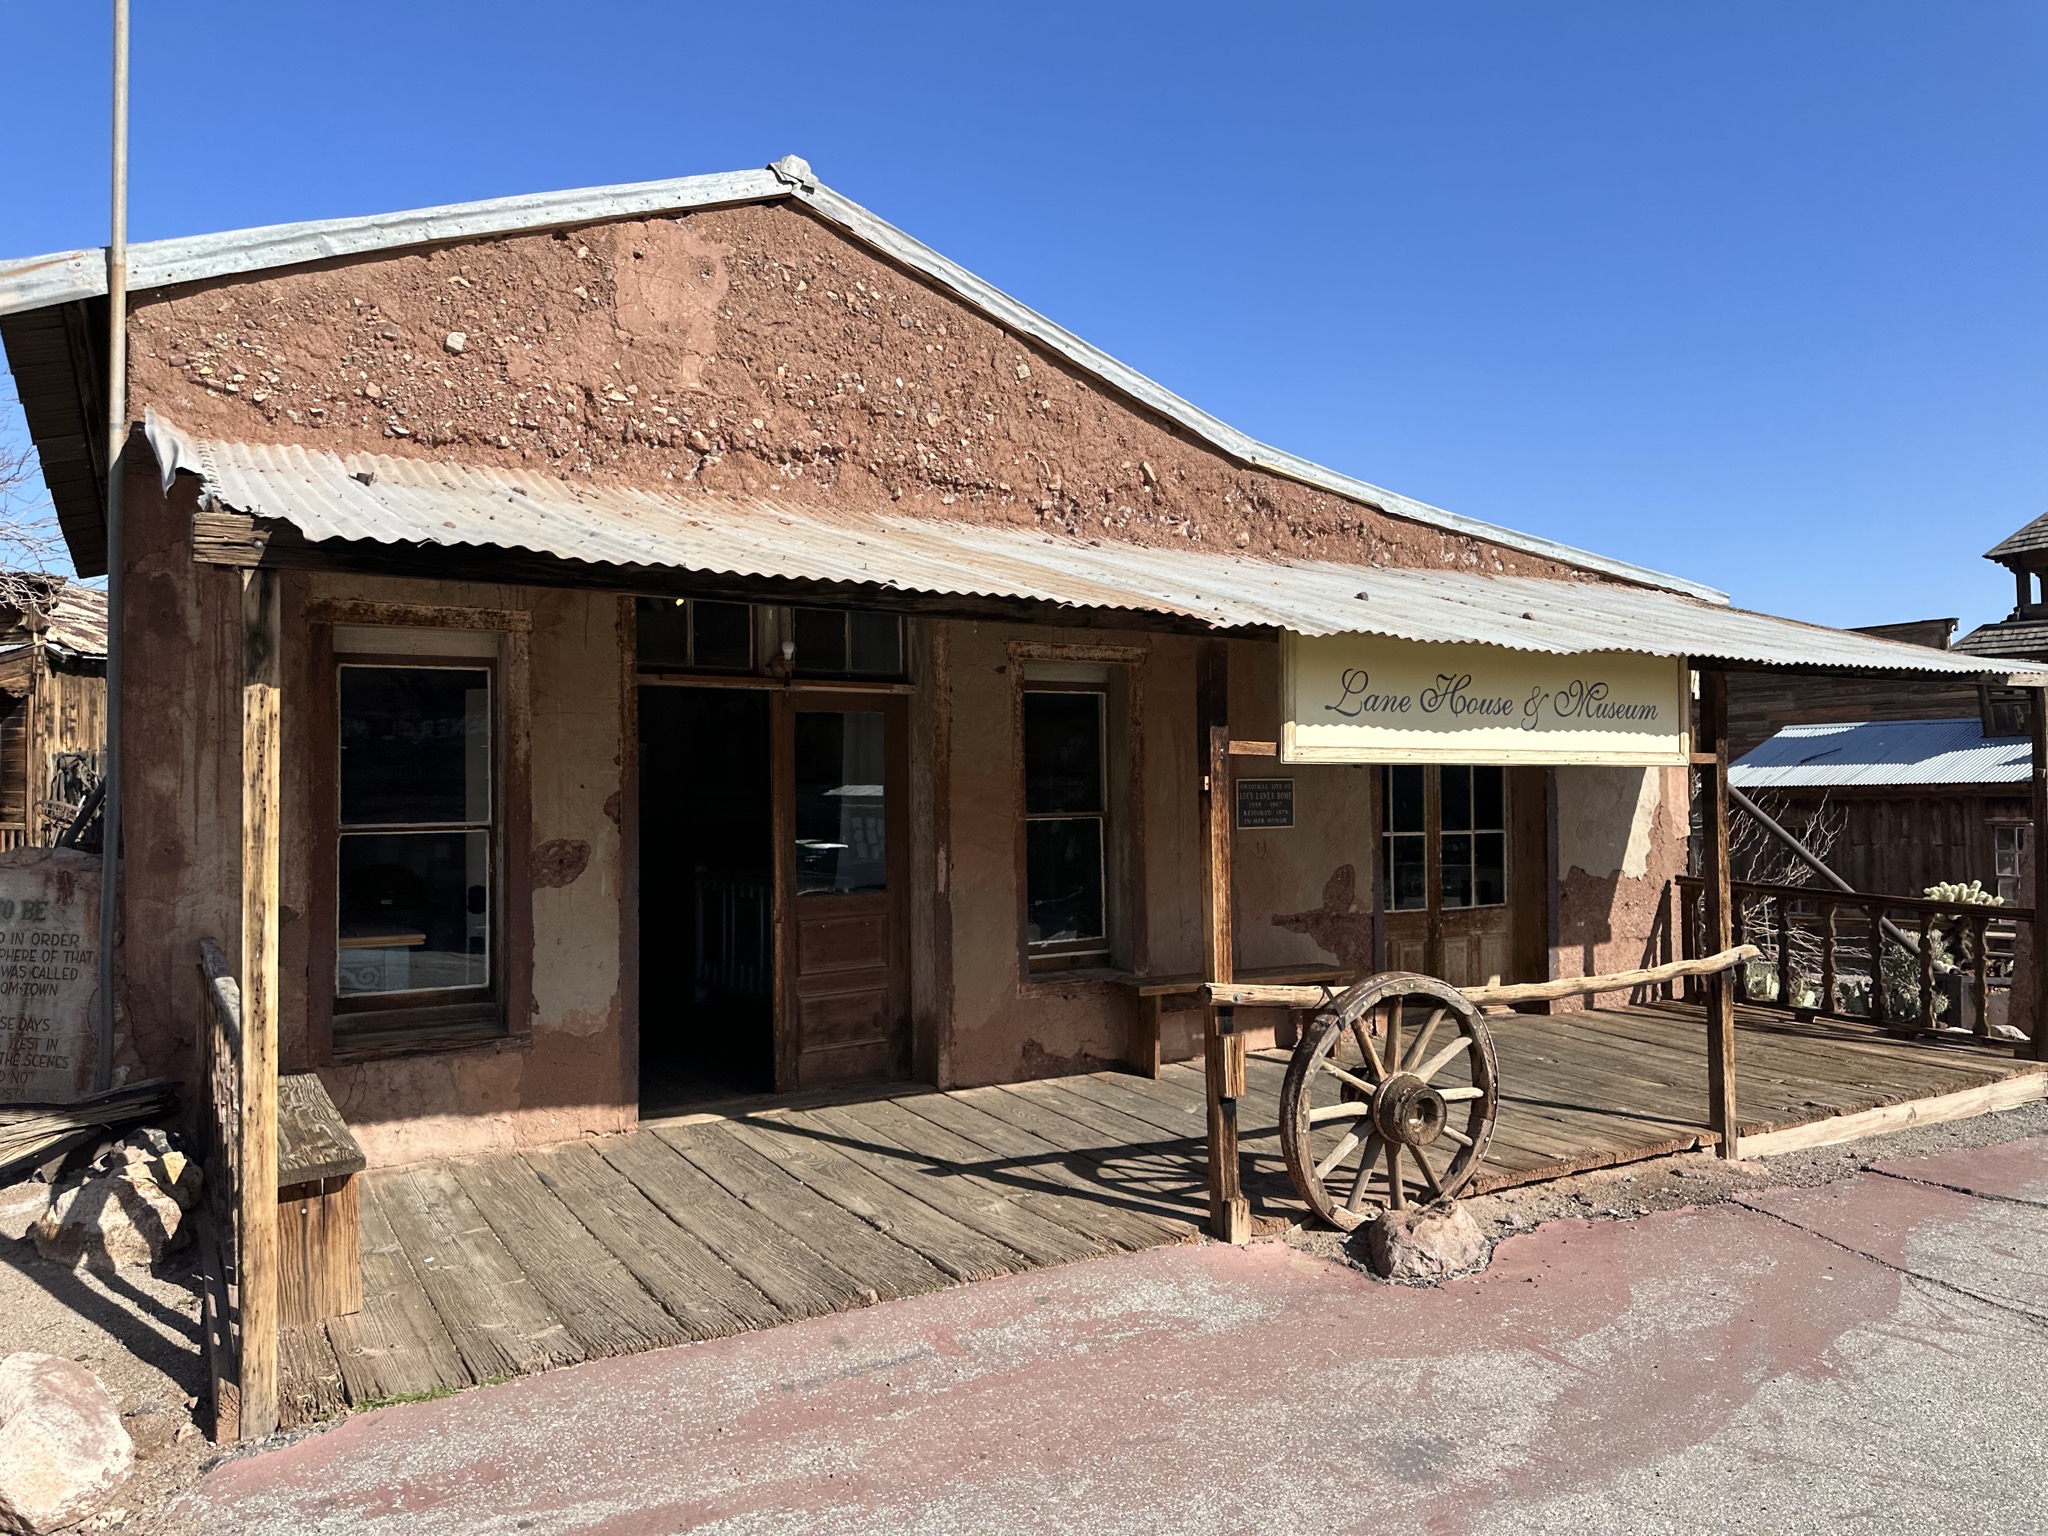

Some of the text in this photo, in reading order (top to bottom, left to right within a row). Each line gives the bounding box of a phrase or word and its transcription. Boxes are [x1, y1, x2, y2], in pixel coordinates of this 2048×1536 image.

[1324, 668, 1659, 731] Lane House & Museum
[1239, 791, 1253, 800] LUCY
[1243, 809, 1272, 817] RESTORED
[1244, 817, 1252, 825] IN
[1253, 817, 1265, 825] HER
[20, 900, 49, 922] BE
[11, 932, 25, 945] IN
[31, 932, 80, 947] ORDER
[42, 949, 59, 963] OF
[63, 950, 95, 964] THAT
[1, 965, 79, 981] WAS CALLED
[18, 1017, 50, 1032] DAYS
[9, 1035, 42, 1051] WEST
[46, 1038, 59, 1051] IN
[22, 1053, 70, 1069] SCENES
[10, 1070, 37, 1084] NOT
